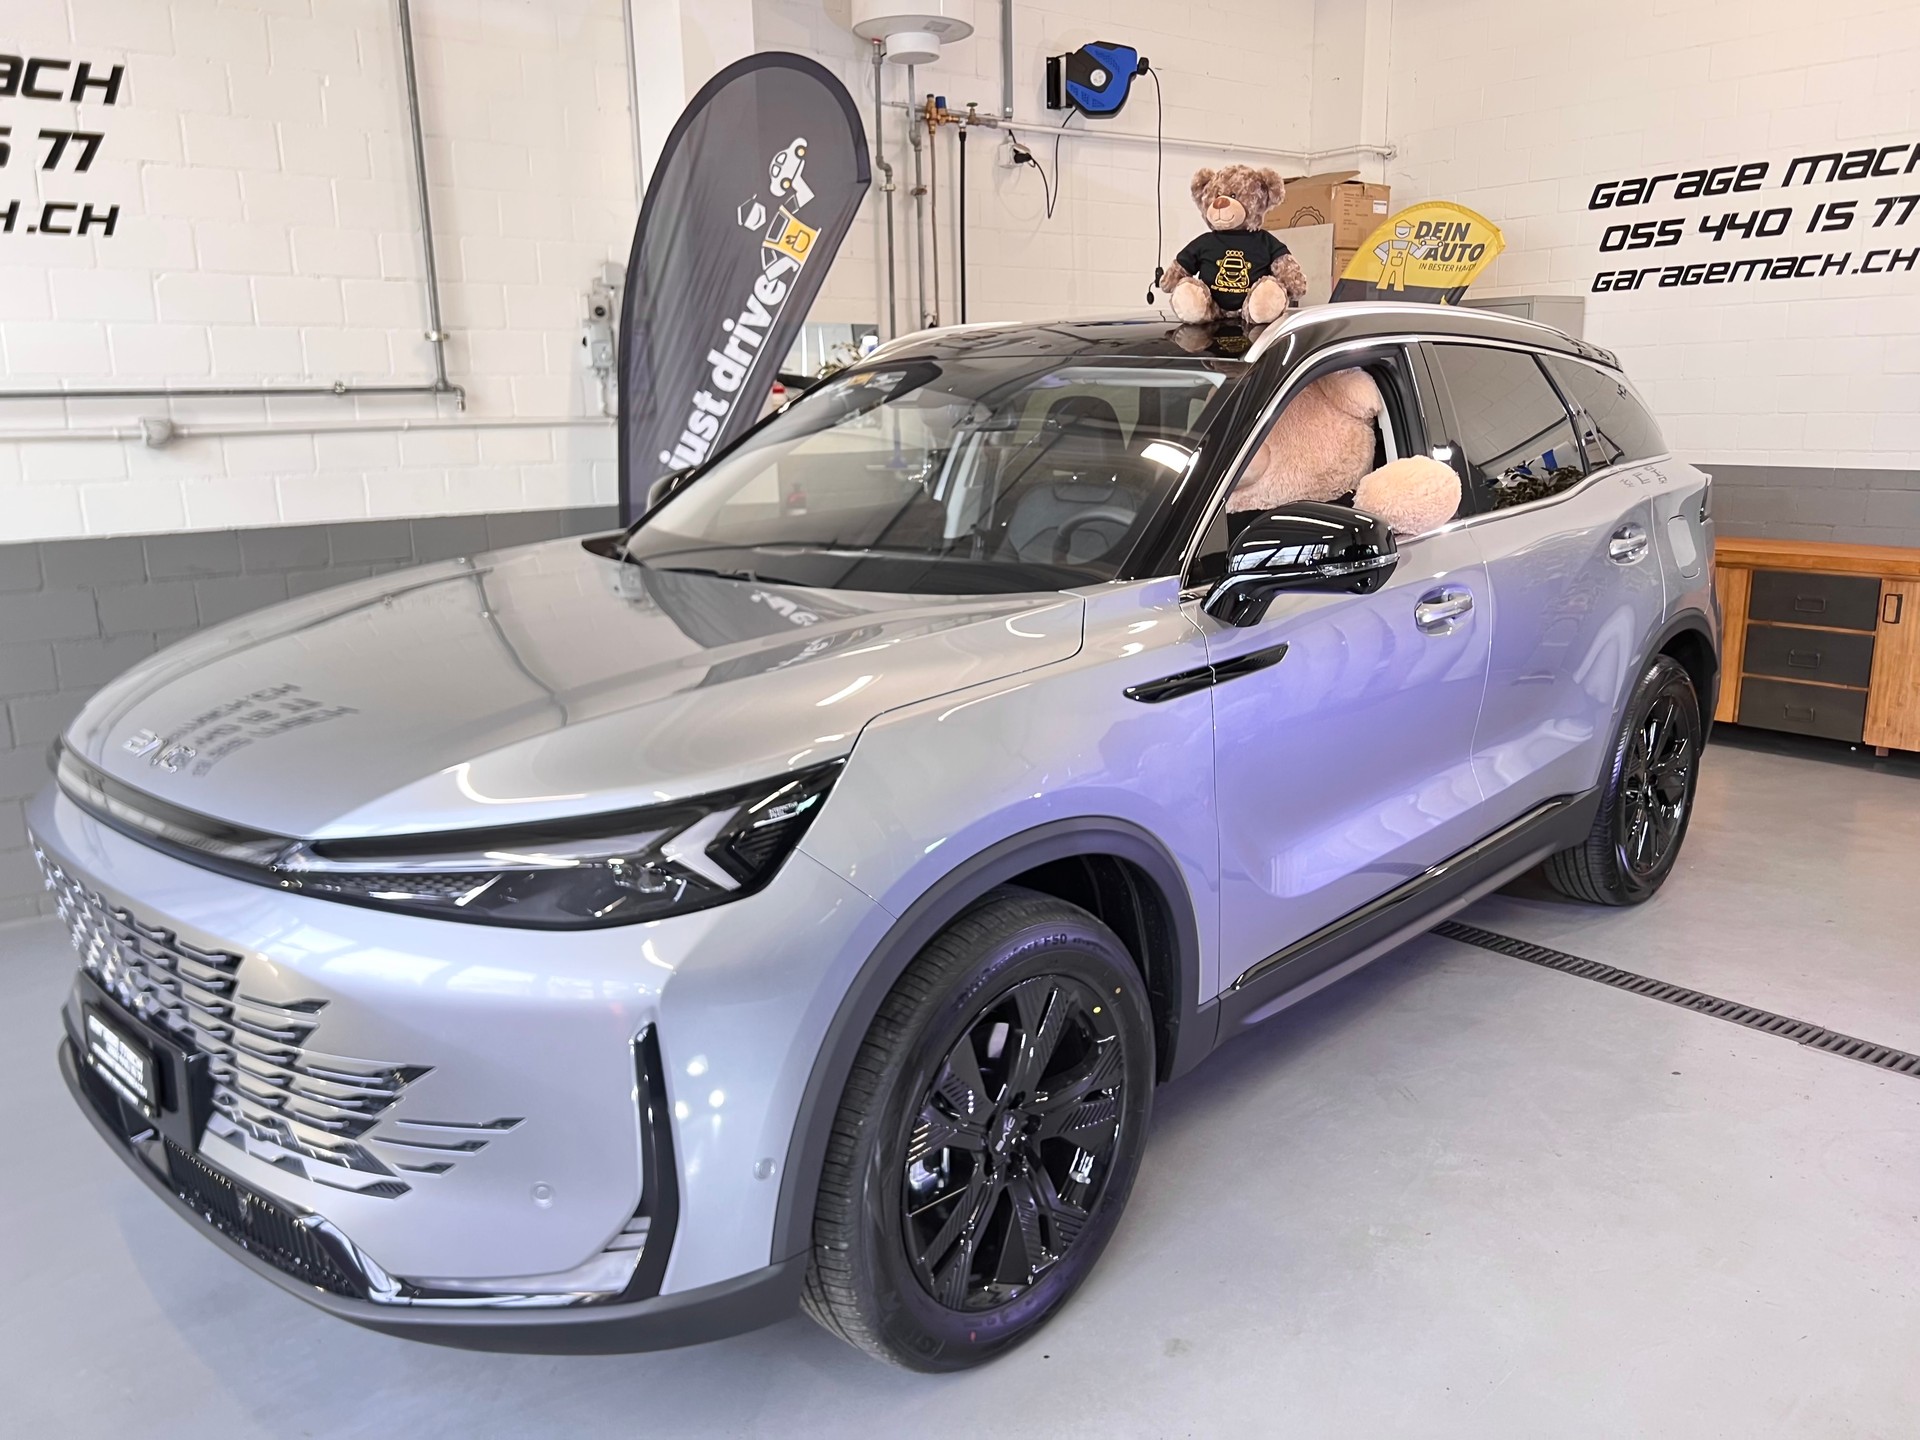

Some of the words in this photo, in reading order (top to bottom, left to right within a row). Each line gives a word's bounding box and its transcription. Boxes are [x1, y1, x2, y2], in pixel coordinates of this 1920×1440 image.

[1414, 221, 1471, 242] DEIN
[1599, 218, 1686, 252] 055
[1699, 207, 1792, 241] 440
[1806, 200, 1858, 233] 15
[1872, 194, 1920, 228] 77
[1423, 242, 1485, 262] AUTO
[1419, 262, 1427, 270] IN
[1428, 263, 1454, 272] BESTER
[659, 391, 730, 470] just
[707, 274, 787, 392] drive
